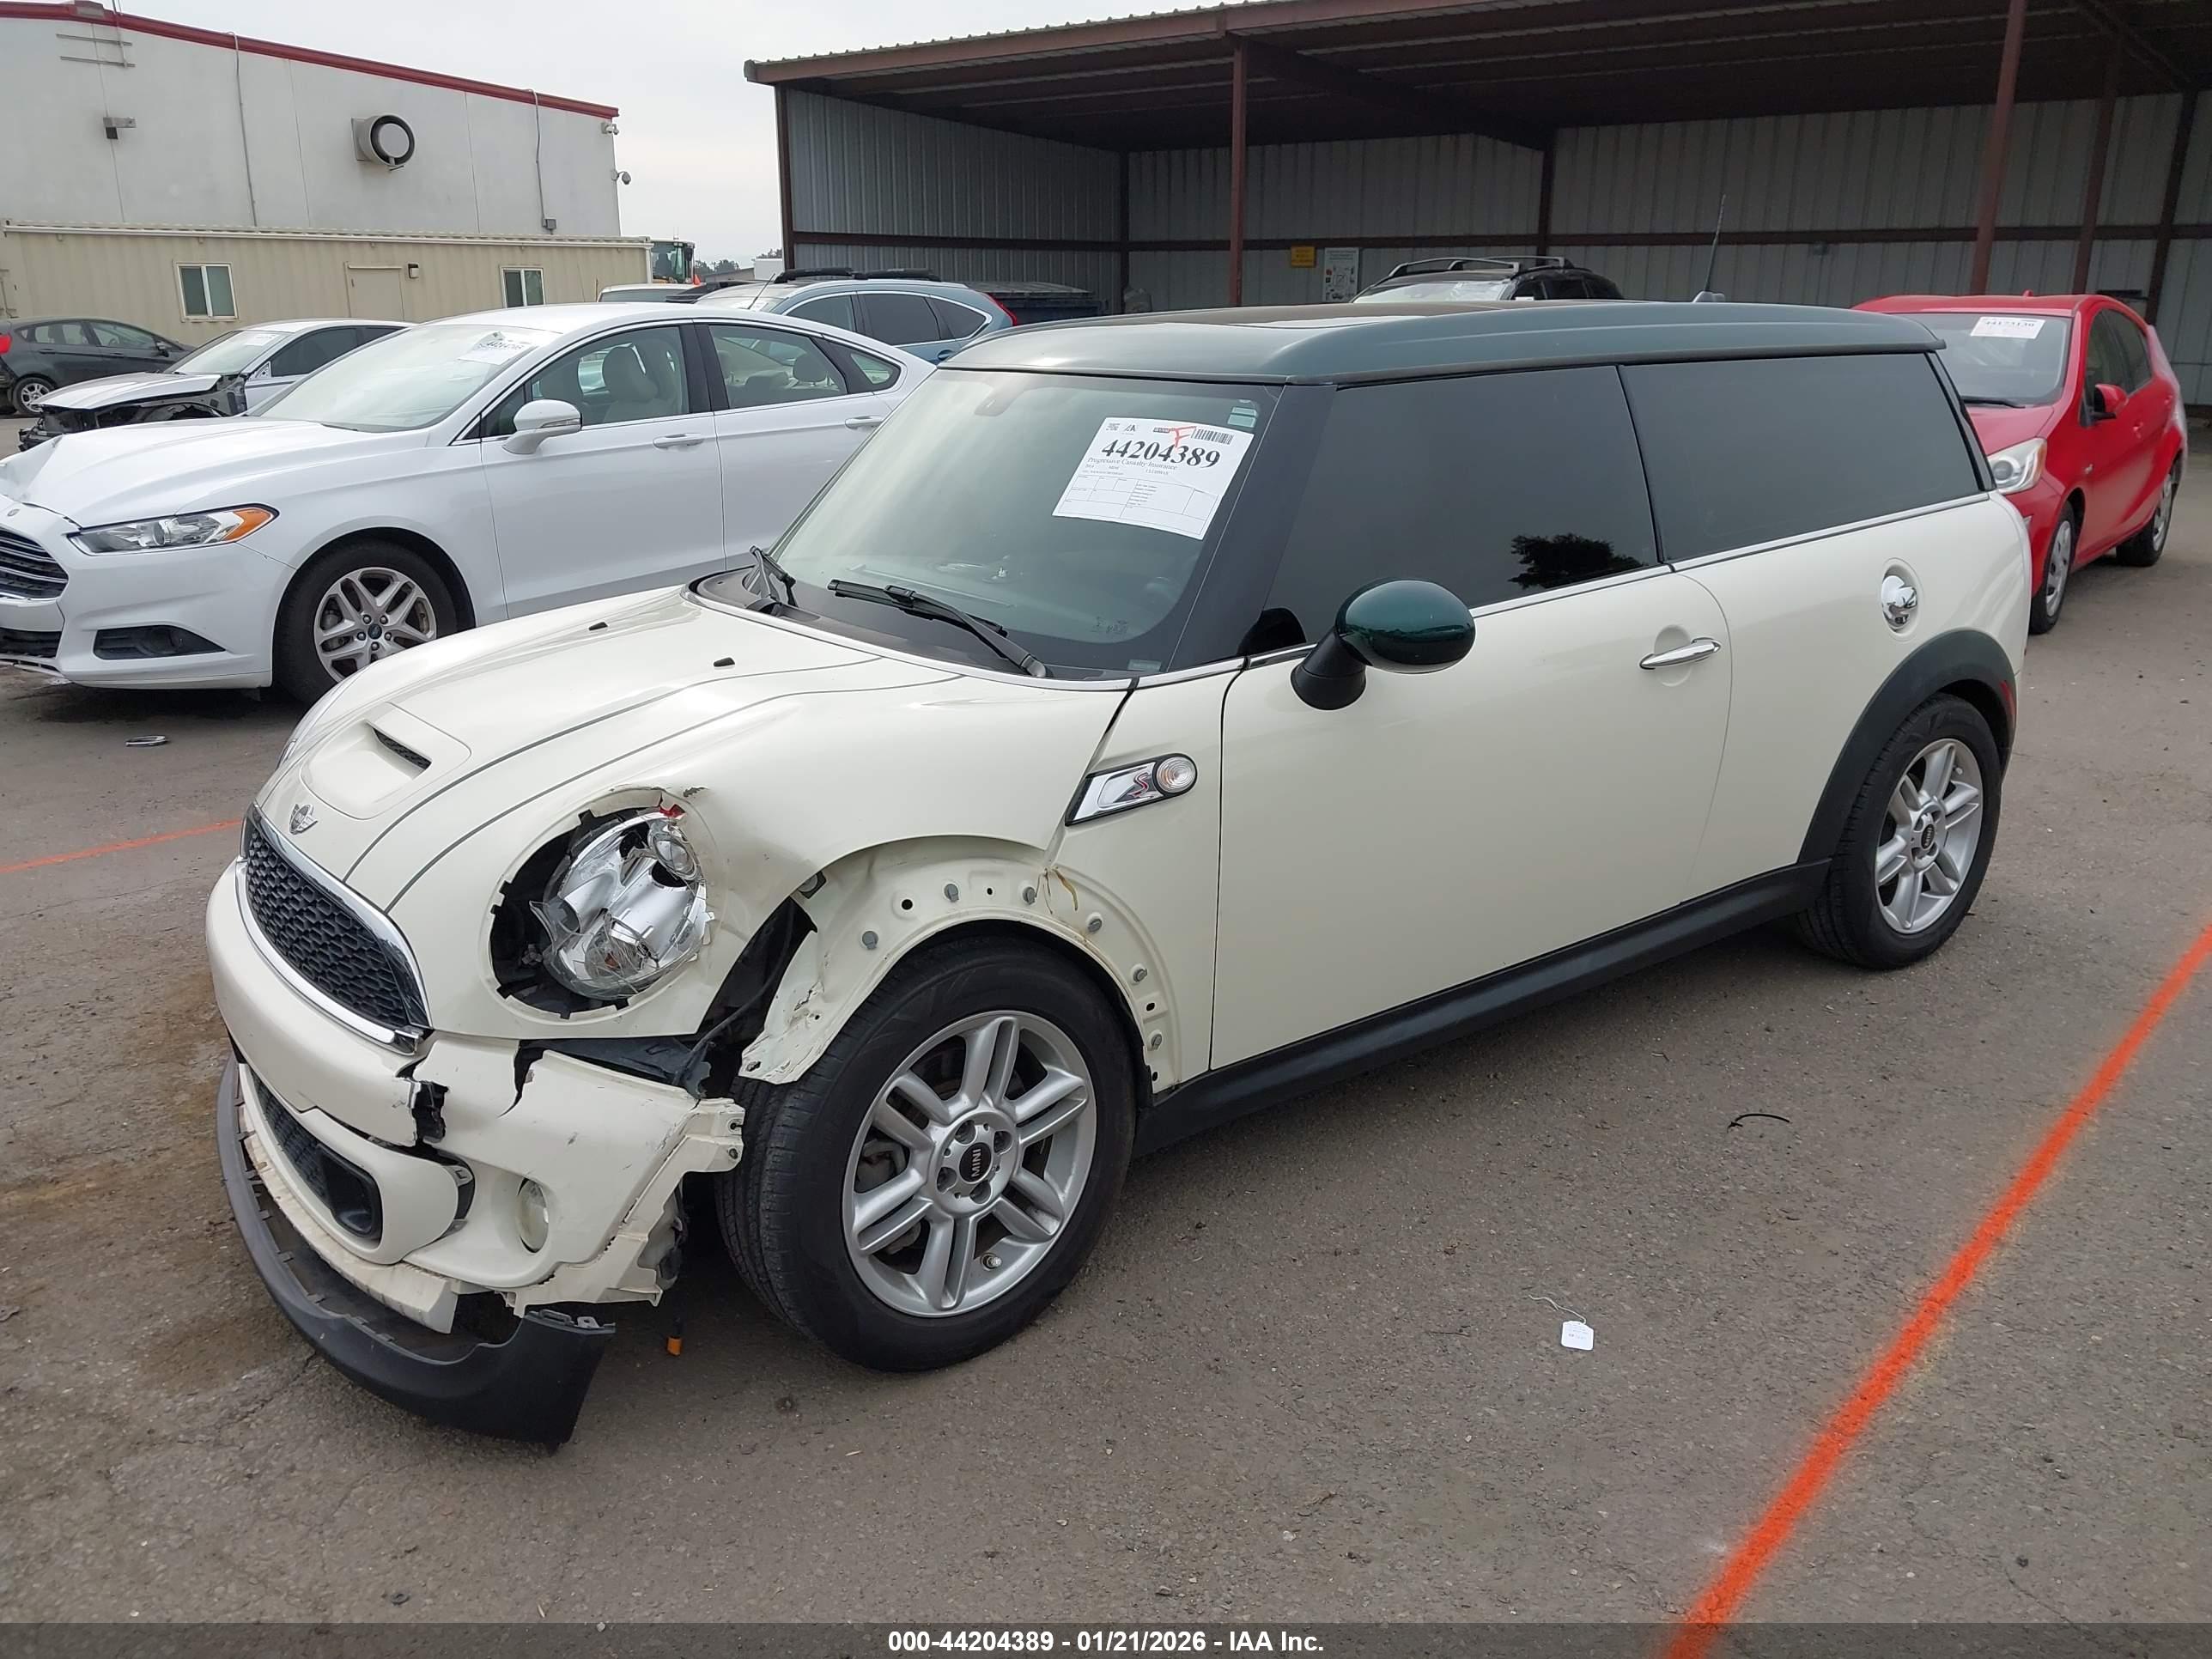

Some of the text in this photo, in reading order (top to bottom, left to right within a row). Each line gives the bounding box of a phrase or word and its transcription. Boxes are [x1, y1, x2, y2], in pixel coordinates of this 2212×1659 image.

[1101, 439, 1222, 469] 44204389
[1121, 459, 1148, 467] Casualty
[1147, 461, 1178, 471] Insurance
[970, 1148, 981, 1177] MINI
